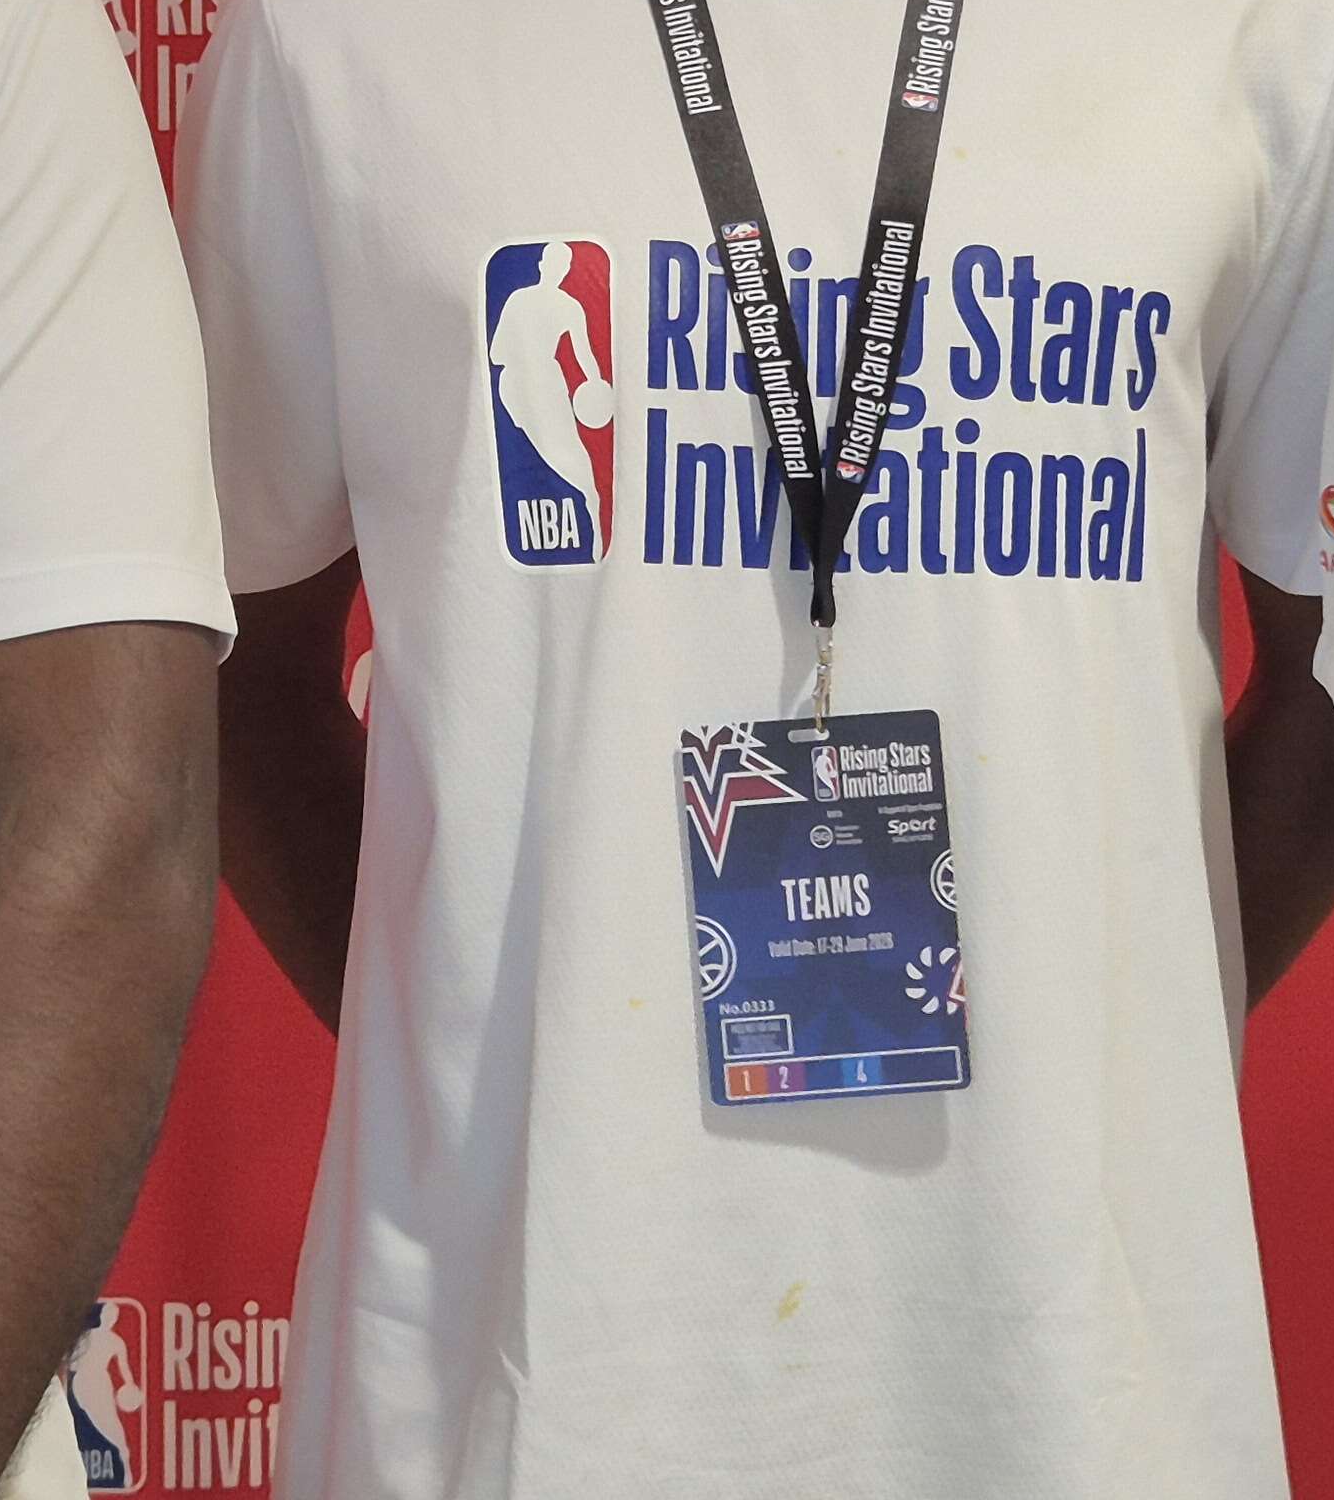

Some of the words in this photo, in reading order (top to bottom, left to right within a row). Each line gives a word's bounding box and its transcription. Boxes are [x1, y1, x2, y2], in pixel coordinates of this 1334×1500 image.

[663, 4, 722, 115] Invitational
[905, 35, 954, 95] Rising
[726, 239, 768, 304] Rising
[859, 220, 915, 340] Invitational
[647, 240, 929, 431] Riing
[949, 244, 1171, 412] Stars
[743, 304, 783, 360] Stars
[851, 339, 893, 397] Stars
[758, 360, 814, 479] Invitational
[840, 395, 887, 466] Rising
[518, 497, 580, 551] NBA
[643, 408, 1147, 583] Invational
[839, 745, 888, 773] Rising
[889, 742, 931, 768] Stars
[842, 767, 933, 799] Invitational
[781, 873, 871, 921] TEAMS
[743, 1070, 751, 1092] 1
[778, 1066, 789, 1089] 2
[84, 1449, 114, 1479] BA
